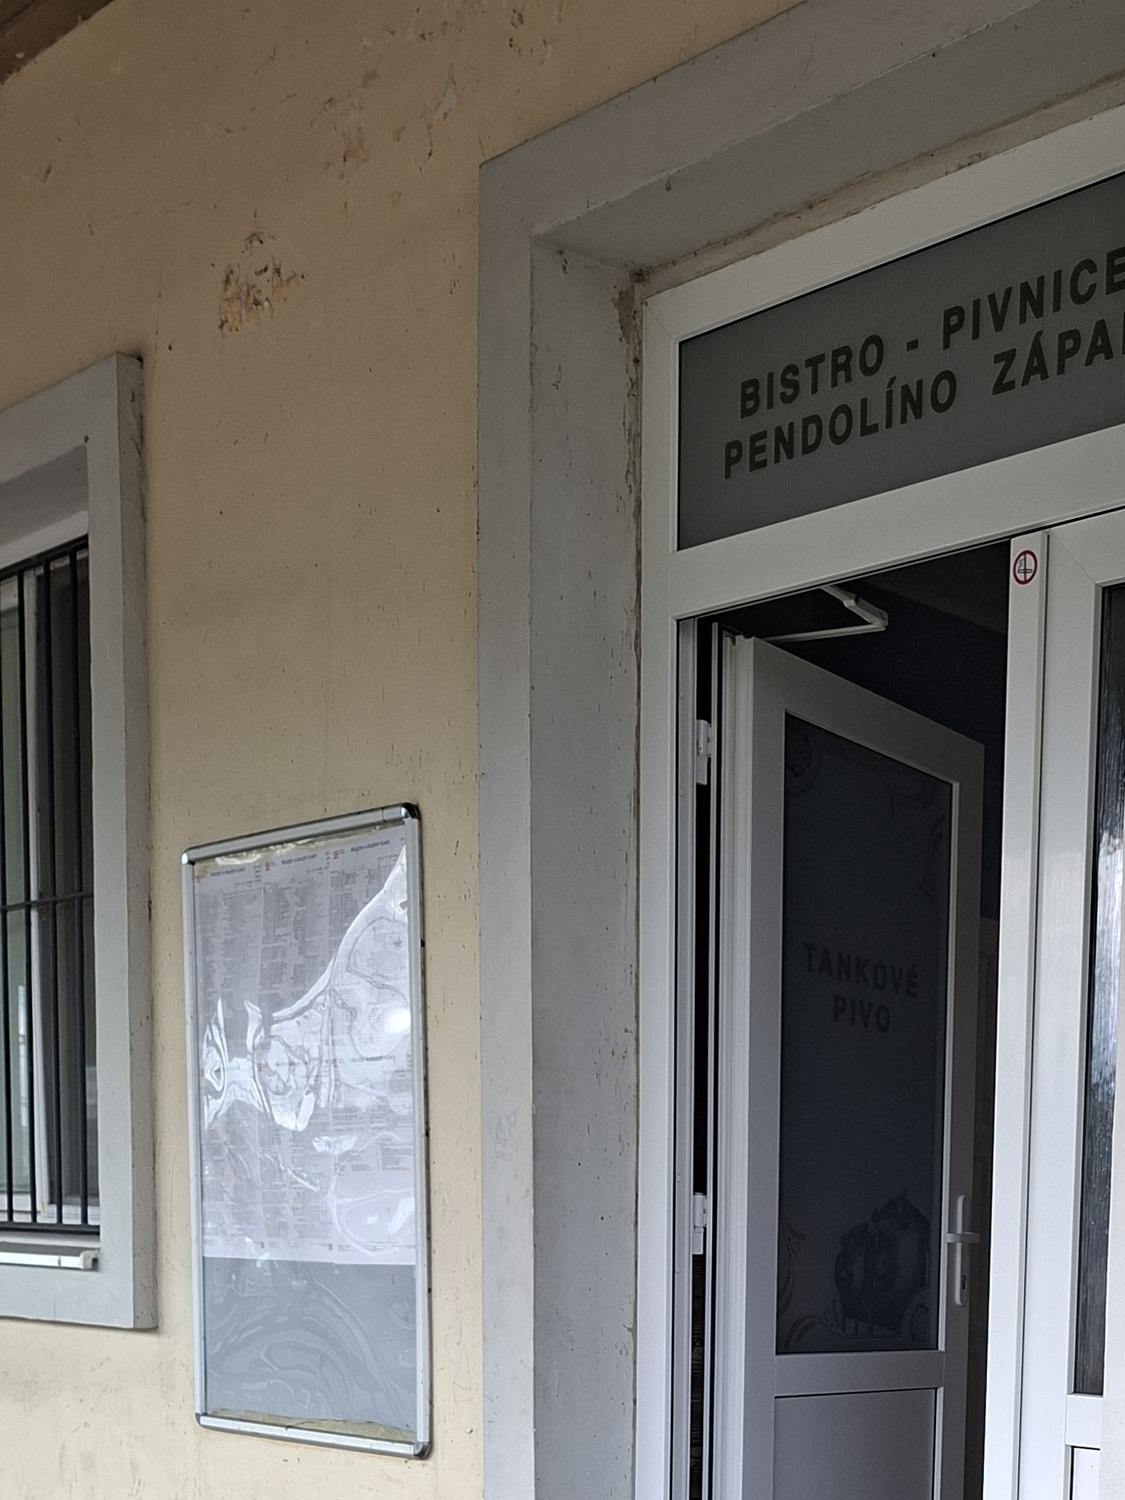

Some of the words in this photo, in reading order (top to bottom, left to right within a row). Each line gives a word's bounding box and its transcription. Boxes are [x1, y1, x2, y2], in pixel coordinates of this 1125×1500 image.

[740, 333, 885, 420] BISTRO
[905, 337, 920, 355] -
[724, 369, 958, 481] PENDOLÍNO
[802, 941, 919, 999] TANKOVÉ
[833, 994, 891, 1034] PIVO
